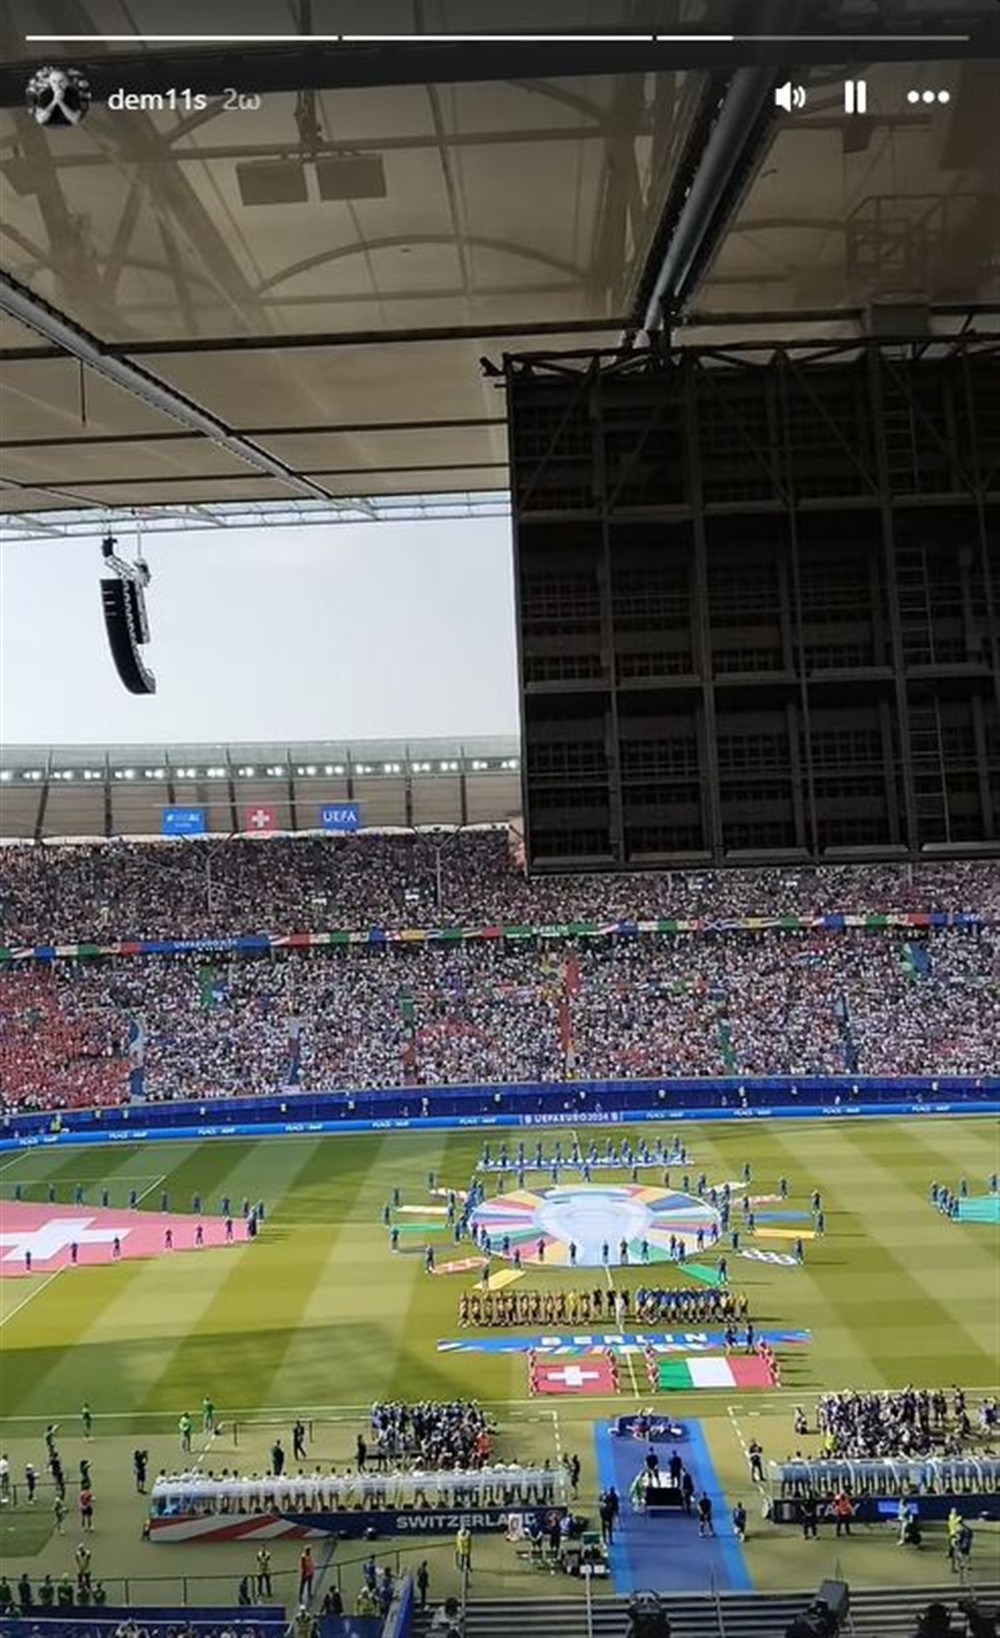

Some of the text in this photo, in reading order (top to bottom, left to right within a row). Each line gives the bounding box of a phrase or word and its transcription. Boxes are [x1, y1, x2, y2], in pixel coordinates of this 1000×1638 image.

[322, 809, 358, 823] UEFA
[541, 1332, 708, 1346] BERLIN
[396, 1512, 536, 1529] SWITZERLAD
